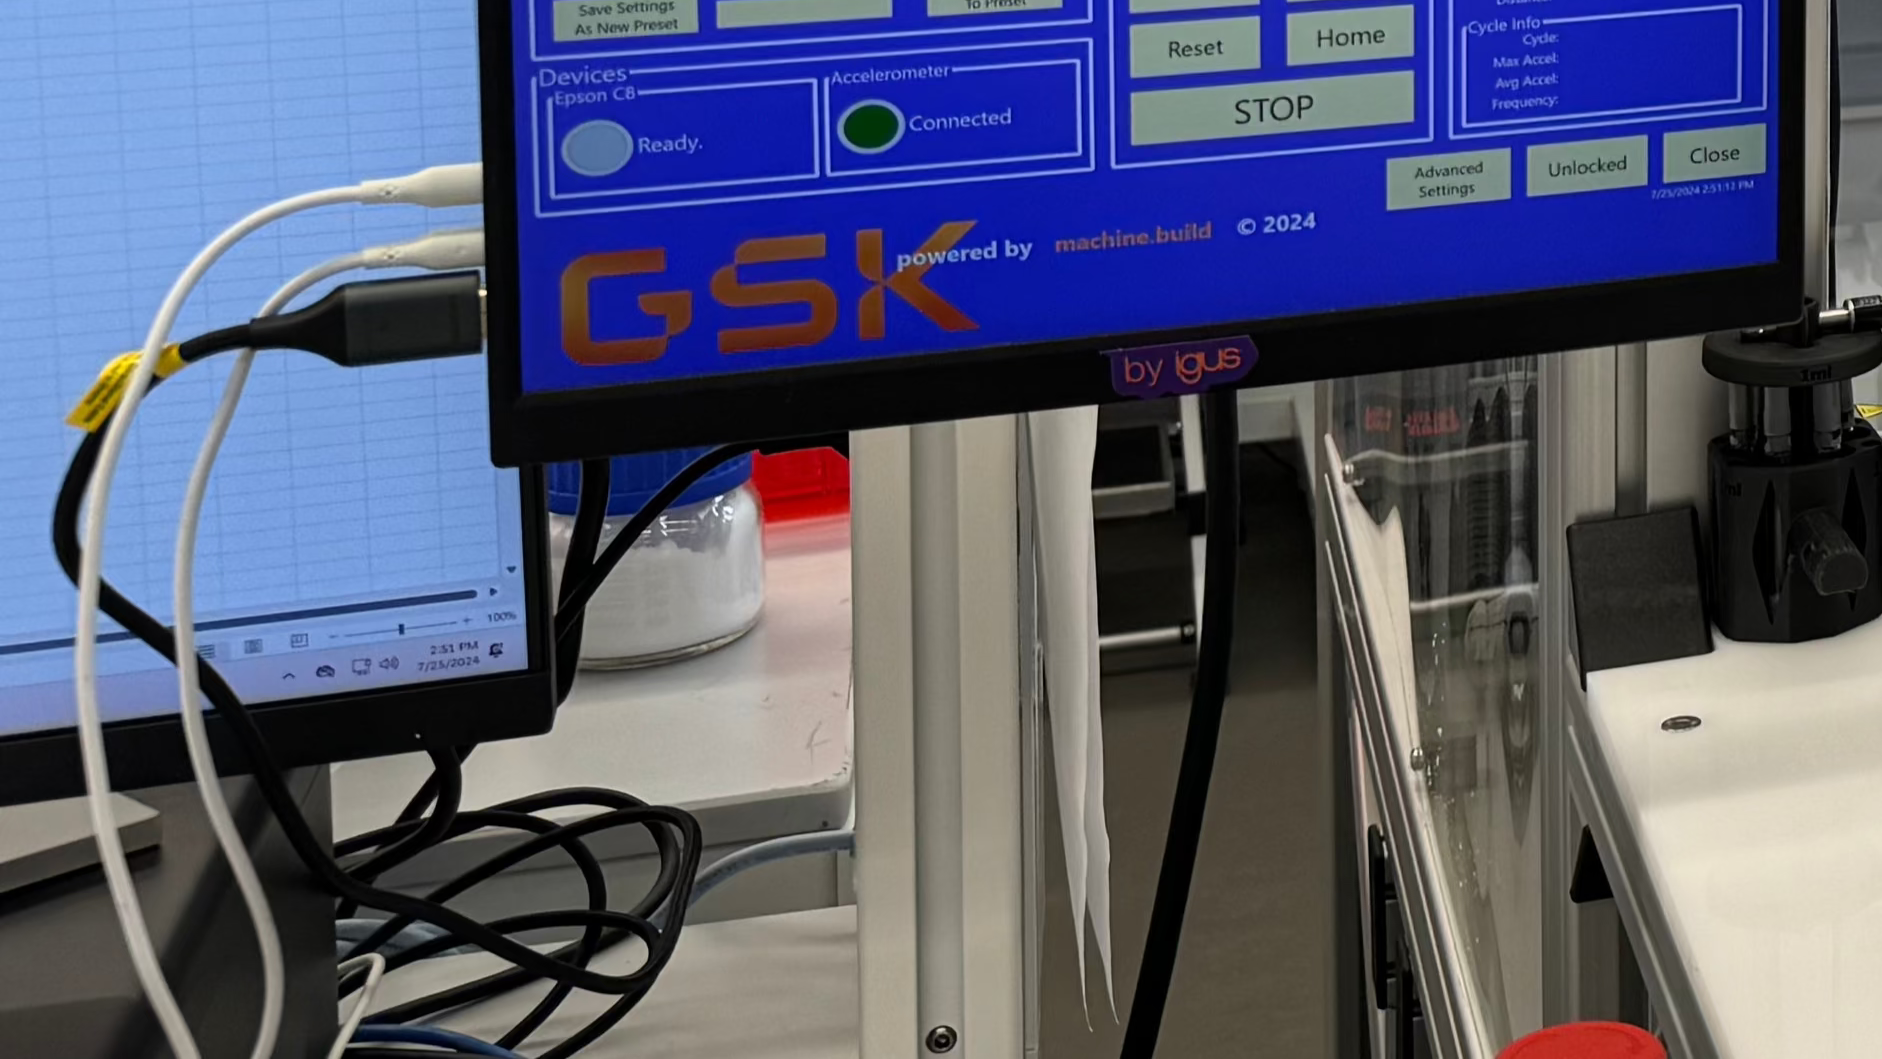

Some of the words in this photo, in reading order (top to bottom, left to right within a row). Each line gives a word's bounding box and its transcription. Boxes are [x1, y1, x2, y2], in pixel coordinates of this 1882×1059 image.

[578, 3, 612, 17] Save
[616, 0, 675, 15] Settings
[574, 23, 592, 36] As
[597, 20, 630, 34] New
[634, 18, 678, 32] Preset
[1467, 18, 1508, 36] Cycle
[1511, 15, 1541, 31] Info
[1316, 28, 1386, 48] Home
[1522, 32, 1559, 47] Cycle:
[1168, 40, 1223, 59] Reset
[1493, 56, 1519, 69] Max
[539, 65, 628, 87] Devices
[831, 62, 951, 86] Accelerometer
[1495, 77, 1519, 91] Avg
[554, 87, 608, 108] Epson
[612, 85, 636, 102] C8
[1491, 95, 1559, 111] Frequency:
[909, 107, 1012, 132] Connected
[1233, 94, 1314, 125] STOP
[638, 134, 703, 155] Ready.
[1690, 145, 1741, 165] Close
[1415, 161, 1484, 180] Advanced
[1548, 155, 1628, 179] Unlocked
[1418, 182, 1475, 200] Settings
[896, 241, 998, 272] powered
[1004, 239, 1034, 261] by
[1055, 221, 1212, 253] machine.build
[1262, 212, 1317, 233] 2024
[561, 220, 980, 366] GSK
[1124, 354, 1163, 387] by
[1174, 346, 1241, 384] igus
[487, 612, 517, 623] 100%
[430, 643, 455, 656] 2:51
[459, 641, 479, 652] PM
